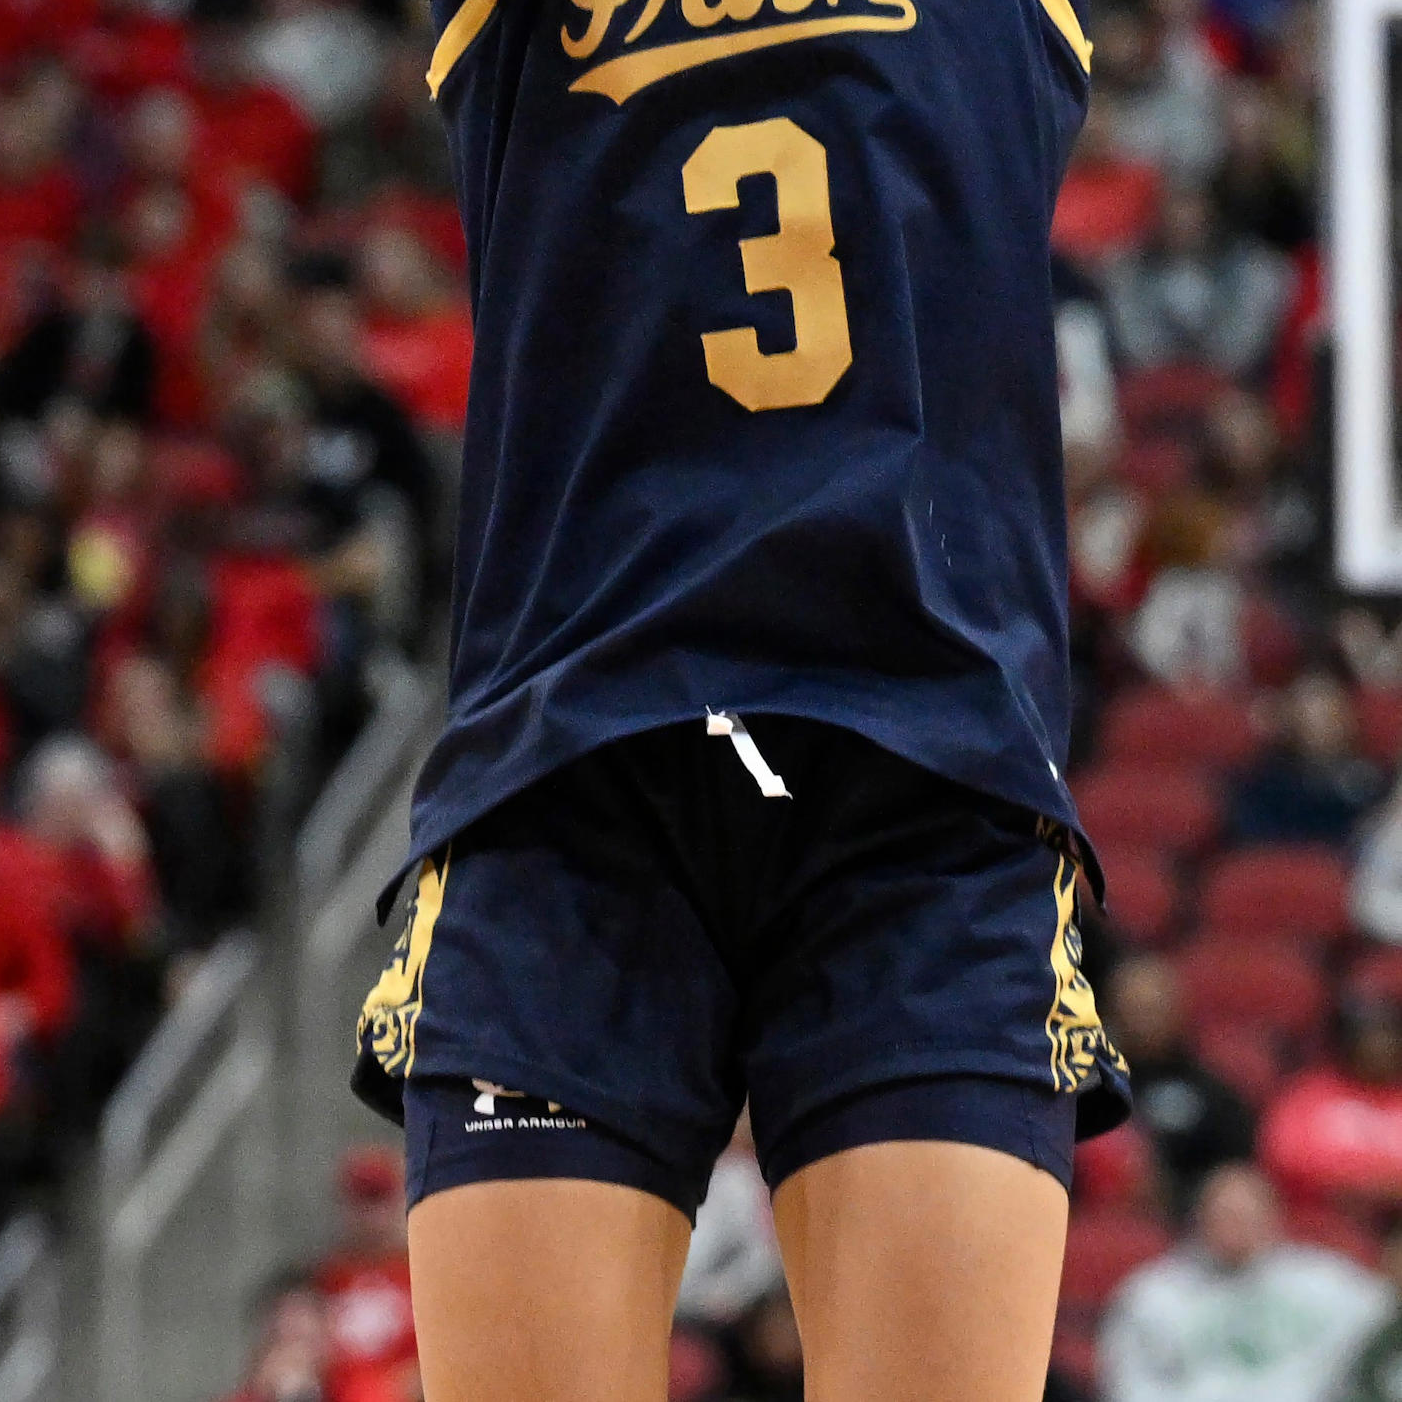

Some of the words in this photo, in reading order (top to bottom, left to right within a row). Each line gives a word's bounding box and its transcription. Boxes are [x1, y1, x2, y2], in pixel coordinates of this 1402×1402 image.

[681, 116, 853, 413] 3
[464, 1117, 514, 1133] UNDER
[517, 1116, 587, 1129] ARMOUR
